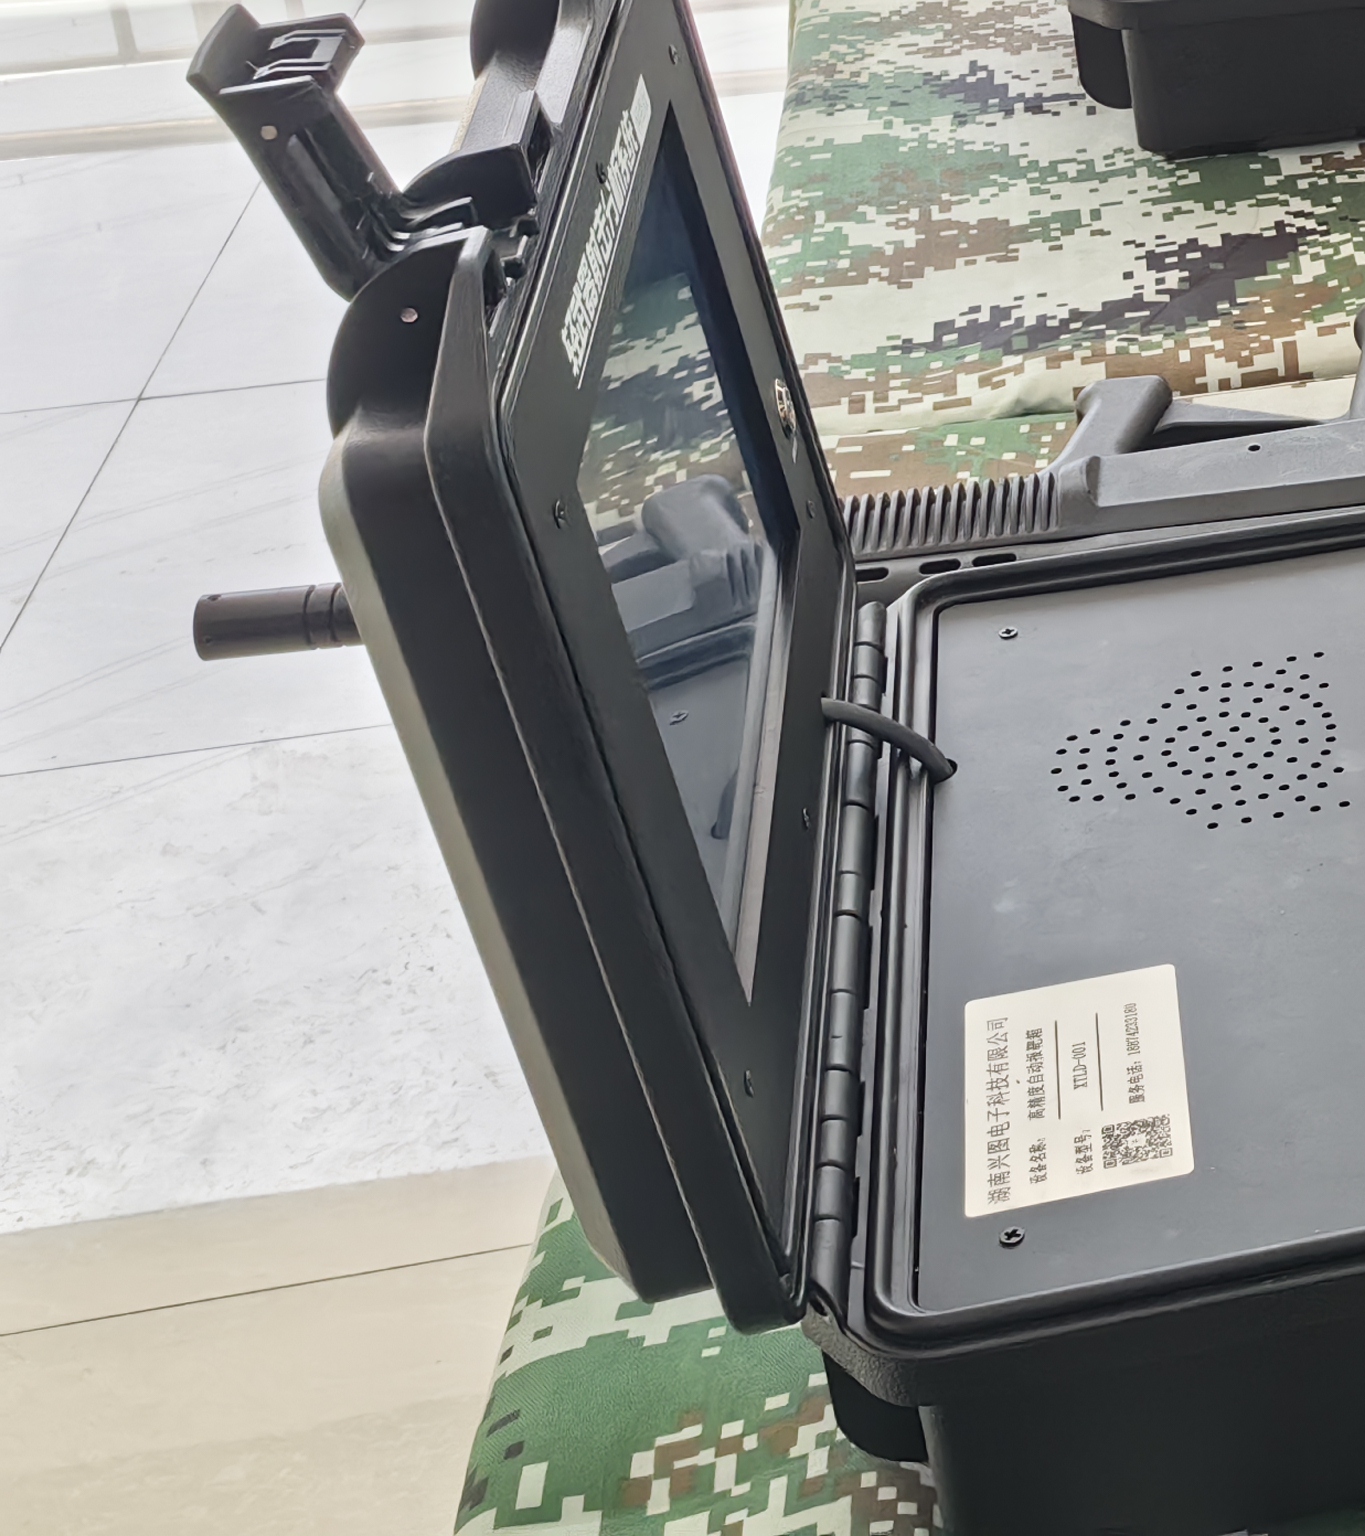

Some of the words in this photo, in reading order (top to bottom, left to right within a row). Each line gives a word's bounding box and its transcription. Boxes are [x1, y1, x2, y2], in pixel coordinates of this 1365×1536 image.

[986, 1016, 1012, 1205] 湖南兴图电子科技有限公司
[1026, 1027, 1046, 1122] 高精度自动报靶箱
[1072, 1041, 1089, 1091] XTLD-001
